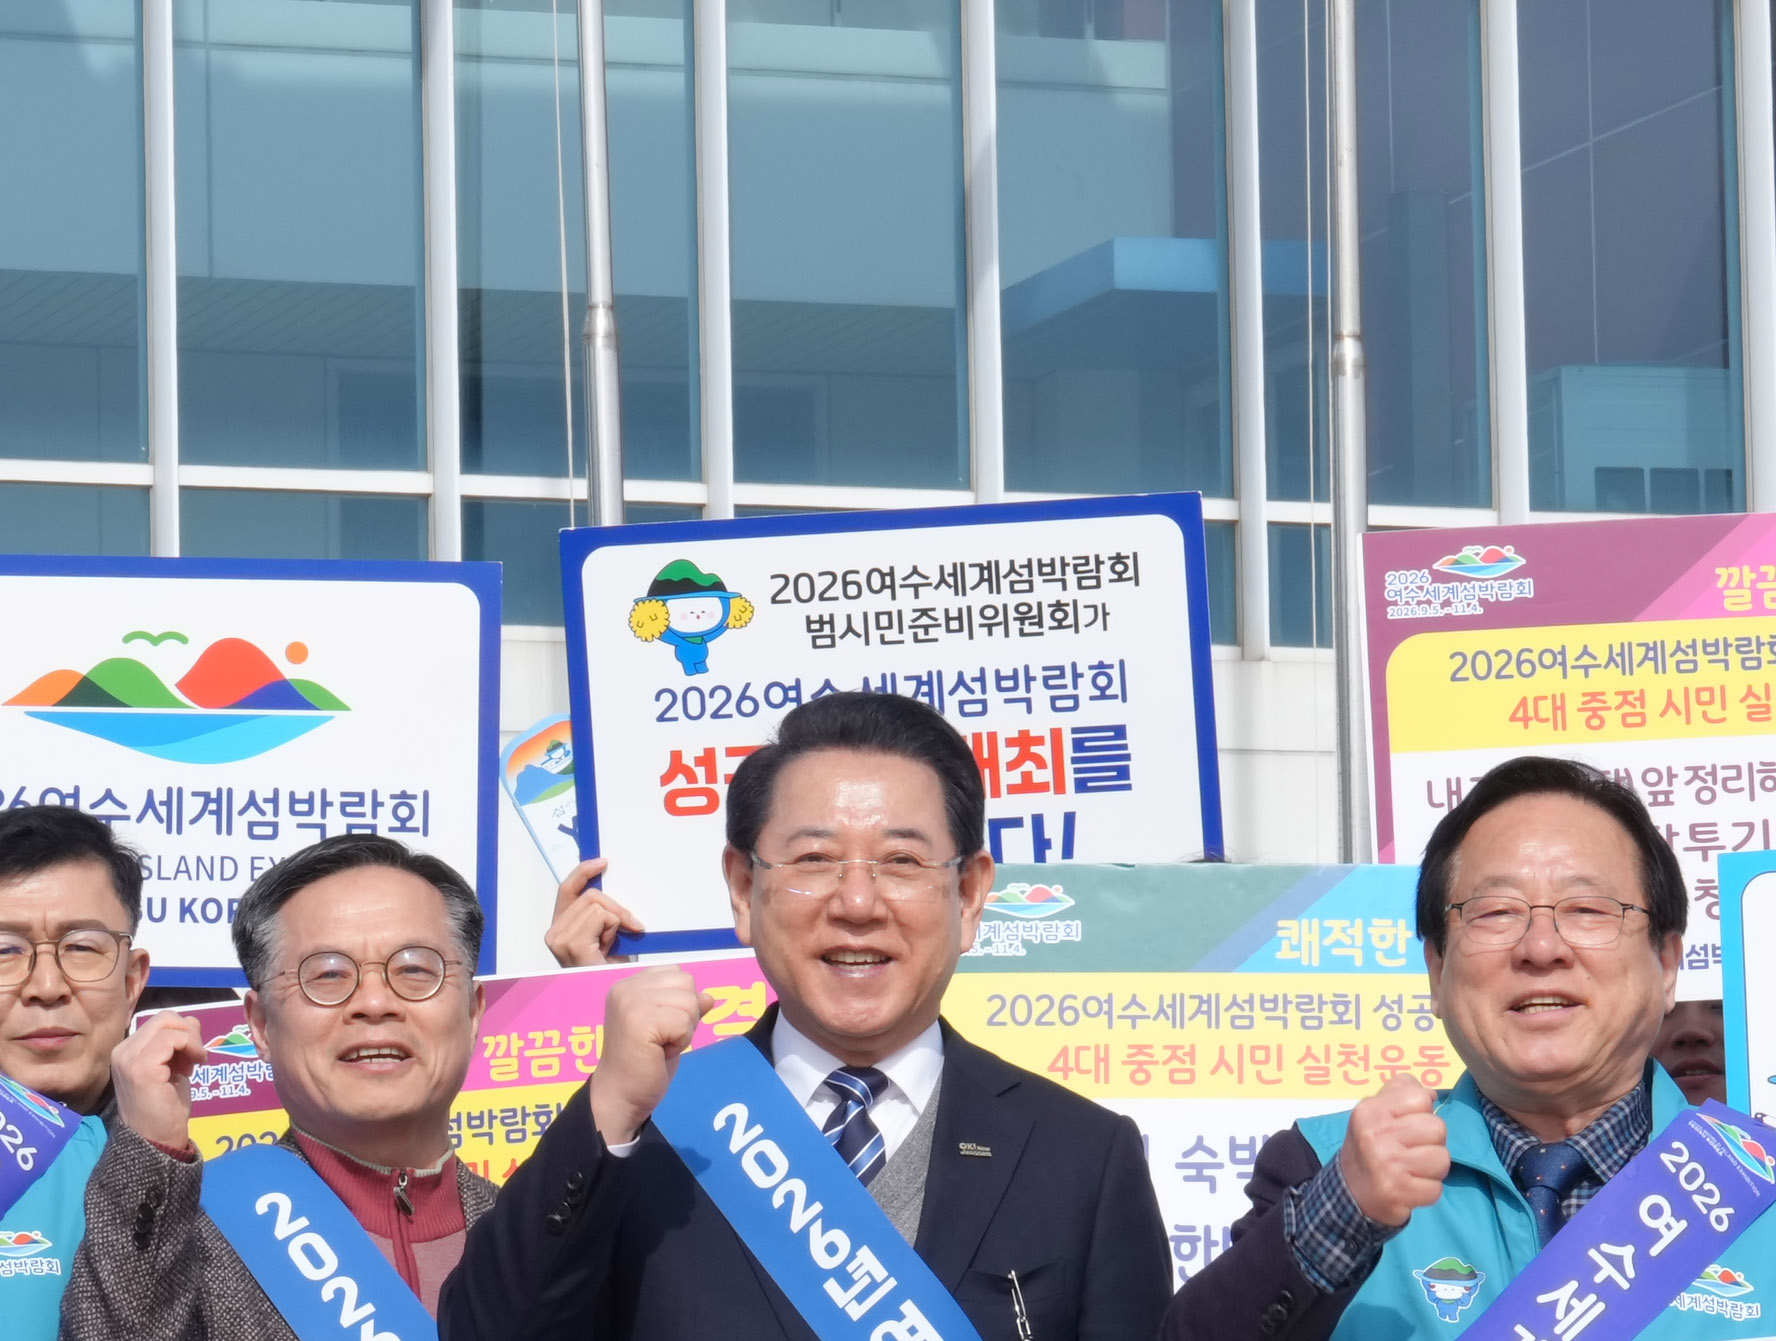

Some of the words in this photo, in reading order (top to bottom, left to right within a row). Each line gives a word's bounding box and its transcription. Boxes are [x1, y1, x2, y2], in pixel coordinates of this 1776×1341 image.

[770, 552, 1140, 606] 2026여수세계섬박람회
[1387, 581, 1532, 602] 여수세계섬박람회
[1388, 571, 1430, 586] 2026
[805, 600, 1110, 650] 범시민준비위원회가
[654, 659, 1127, 724] 2026여계섬박람회
[1508, 692, 1566, 731] 4대
[1577, 689, 1646, 730] 중점
[1659, 684, 1727, 726] 시민
[659, 724, 1132, 817] 성최를
[140, 855, 239, 881] SLAND
[976, 922, 1080, 942] 계섬박람회
[1275, 918, 1413, 966] 쾌적한
[986, 993, 1361, 1031] 2026여수세계섬박람회
[1373, 994, 1442, 1031] 성공
[482, 1025, 605, 1081] 깔끔한
[1048, 1044, 1110, 1084] 4대
[1122, 1043, 1196, 1085] 중점
[1211, 1043, 1284, 1084] 시민
[1297, 1043, 1450, 1086] 실천운동
[1660, 1141, 1735, 1232] 2026
[713, 1102, 897, 1321] 2026년
[1672, 1294, 1760, 1319] 세계섬박람회
